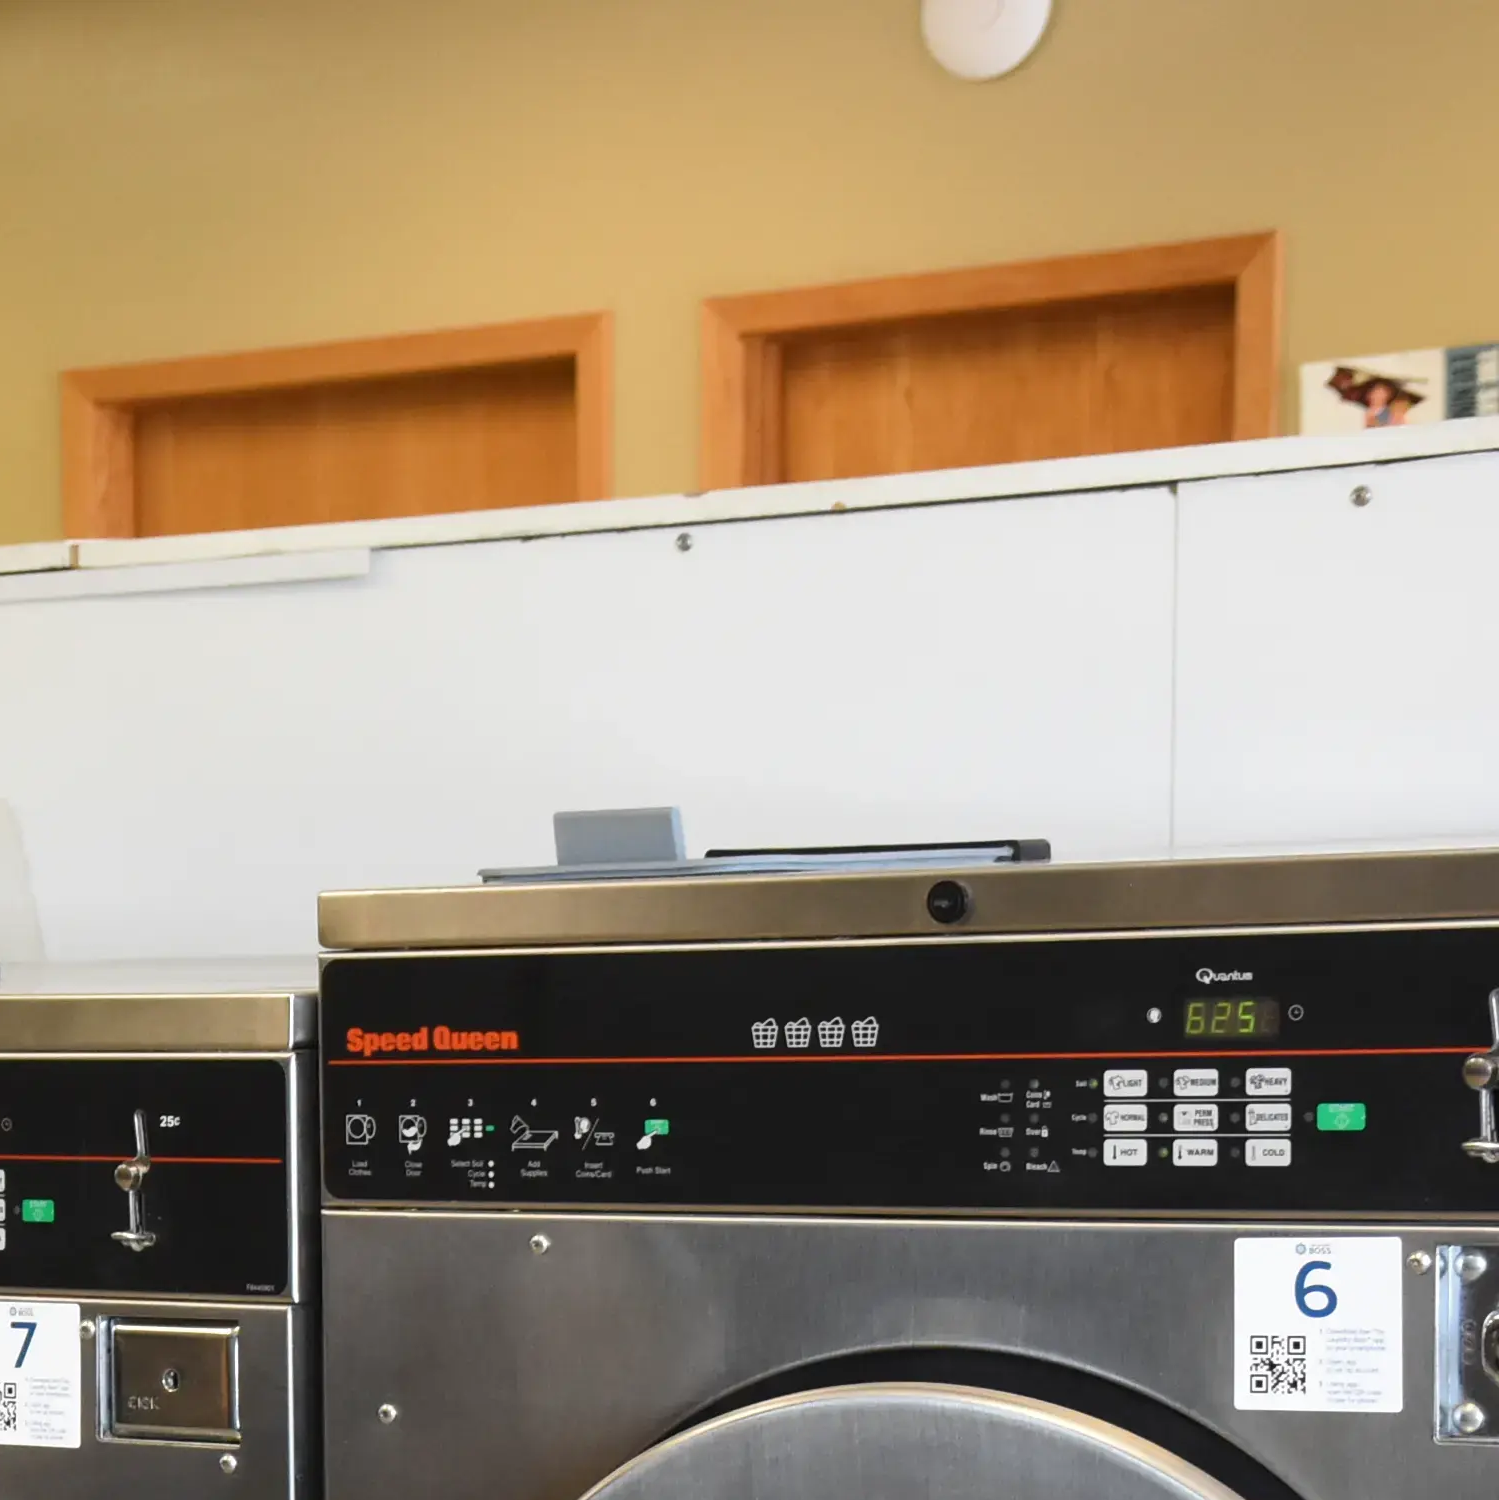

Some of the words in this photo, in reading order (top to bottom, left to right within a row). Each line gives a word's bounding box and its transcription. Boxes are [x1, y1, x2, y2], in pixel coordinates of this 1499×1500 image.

[1185, 1001, 1256, 1034] 625
[346, 1026, 428, 1057] Speed
[432, 1025, 519, 1051] Queen
[1123, 1079, 1142, 1088] LIGHT
[1190, 1078, 1217, 1087] MEDIUM
[1264, 1077, 1288, 1086] HEAVY
[356, 1098, 362, 1107] 1
[410, 1098, 416, 1107] 2
[467, 1098, 474, 1107] 3
[530, 1098, 538, 1107] 4
[590, 1098, 598, 1107] 5
[649, 1098, 657, 1107] 6
[1194, 1109, 1213, 1117] PERM
[1193, 1118, 1214, 1127] PRESS
[1186, 1148, 1214, 1156] WARM
[1262, 1148, 1285, 1157] COLD
[1294, 1260, 1338, 1318] 6
[10, 1321, 38, 1369] 7
